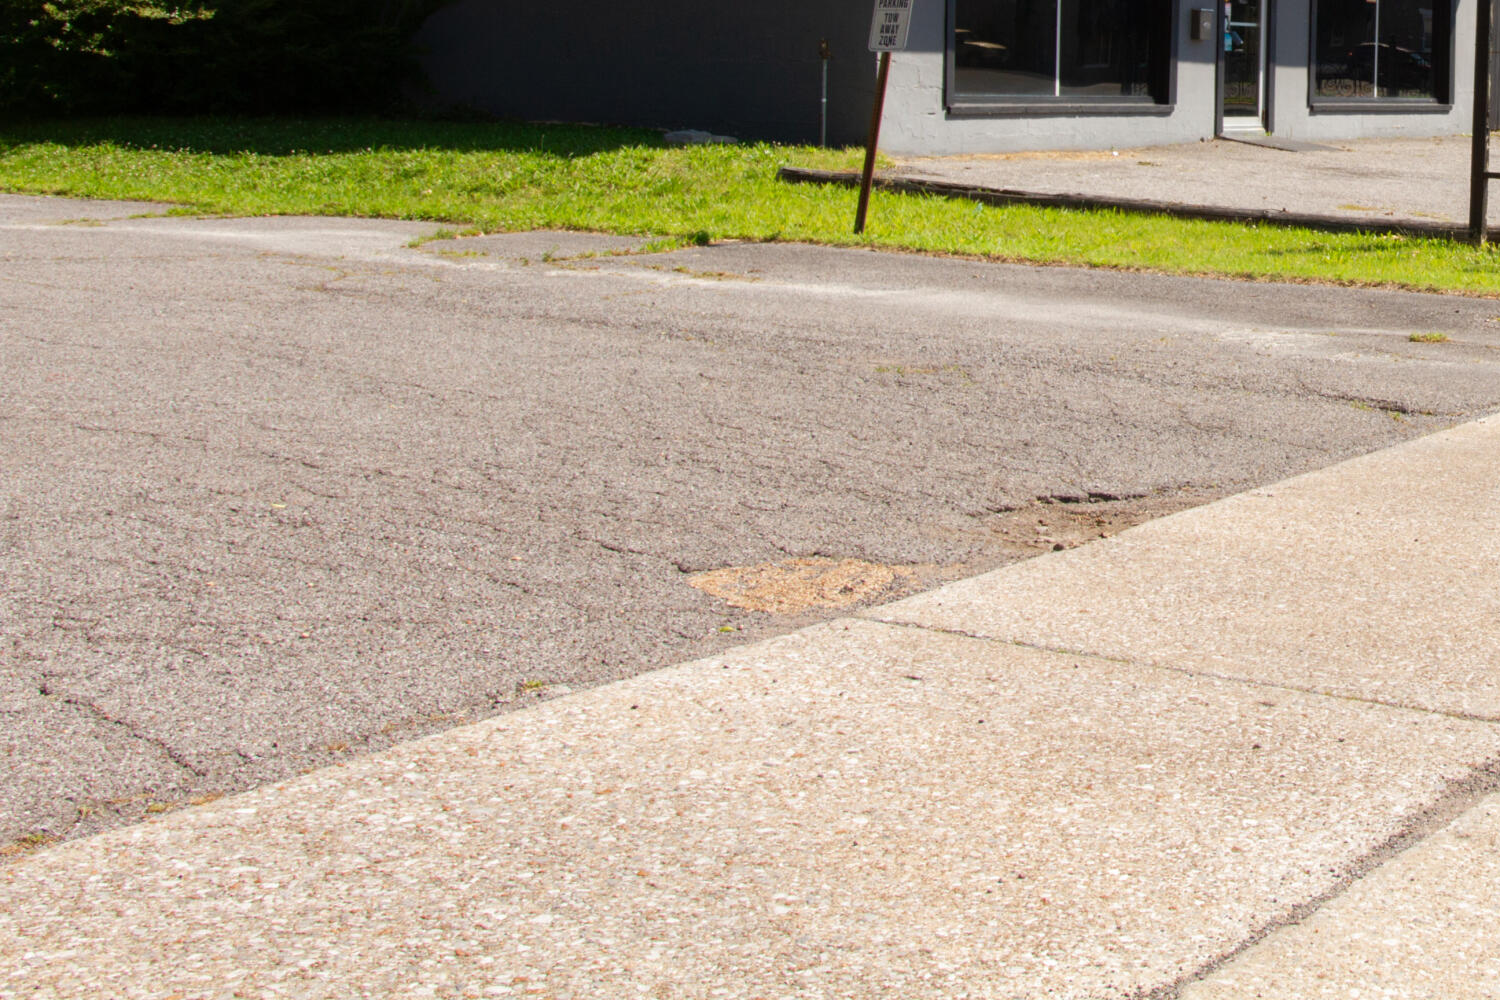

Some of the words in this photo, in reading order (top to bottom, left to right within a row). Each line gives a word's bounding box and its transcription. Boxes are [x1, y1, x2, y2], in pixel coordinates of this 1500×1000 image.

[884, 13, 899, 23] TOW
[880, 24, 899, 34] AWAY
[878, 35, 896, 46] ZONE
